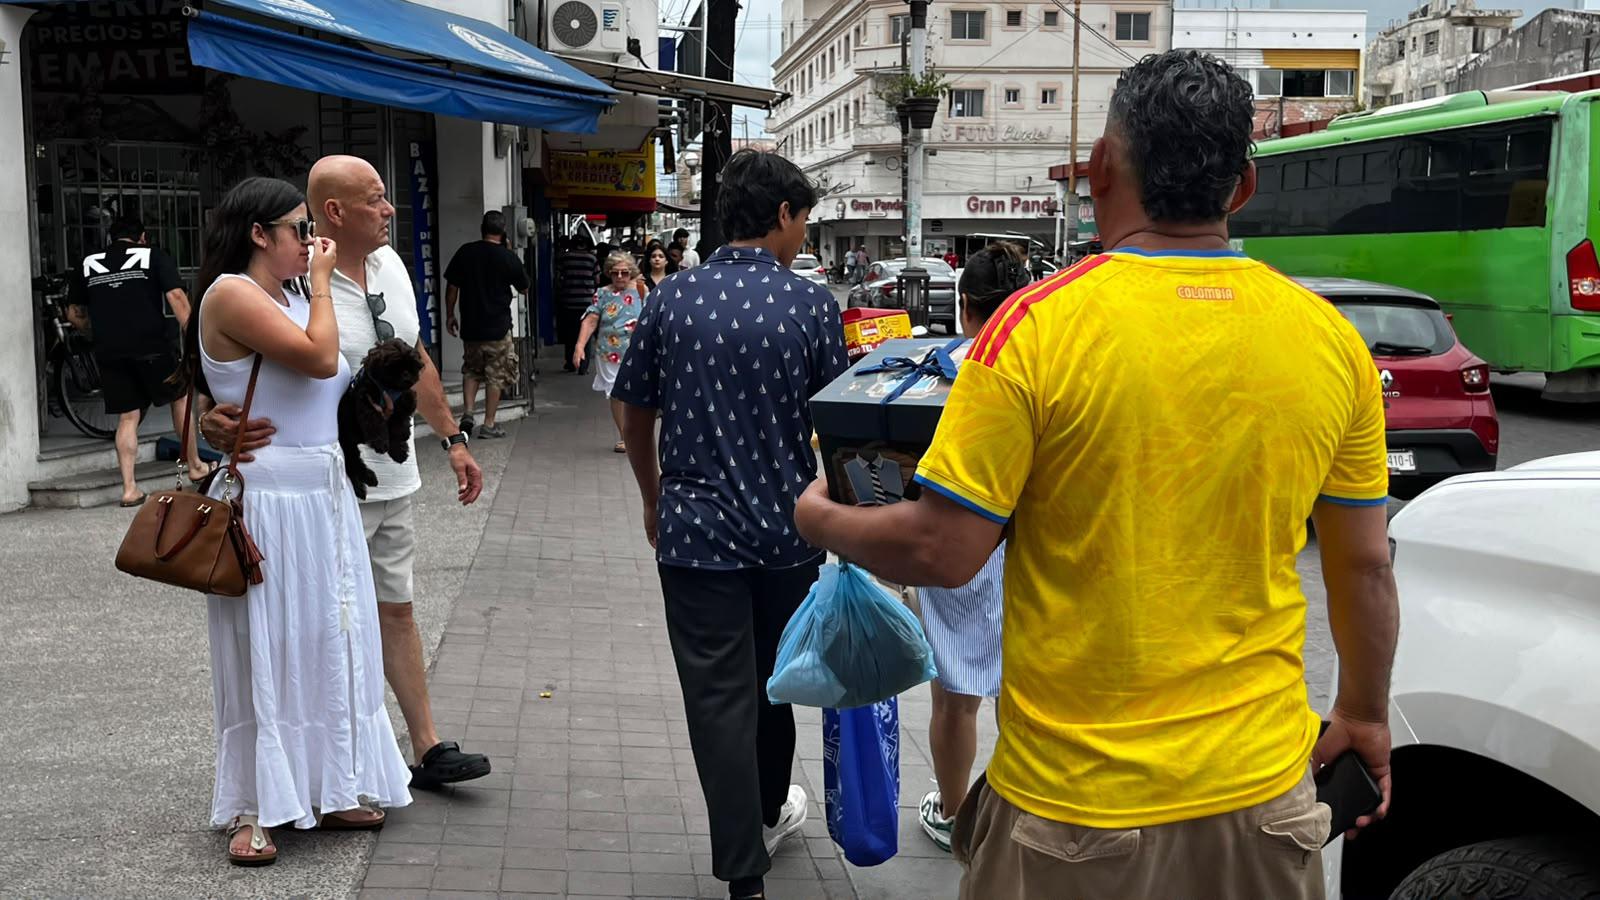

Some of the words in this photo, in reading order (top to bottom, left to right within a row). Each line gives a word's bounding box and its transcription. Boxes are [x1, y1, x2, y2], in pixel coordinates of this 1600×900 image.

[37, 24, 143, 43] PRECIOS
[37, 48, 189, 85] EMATE
[851, 199, 873, 211] Gran
[966, 196, 1005, 213] Gran
[1177, 286, 1233, 300] COLOMBIA
